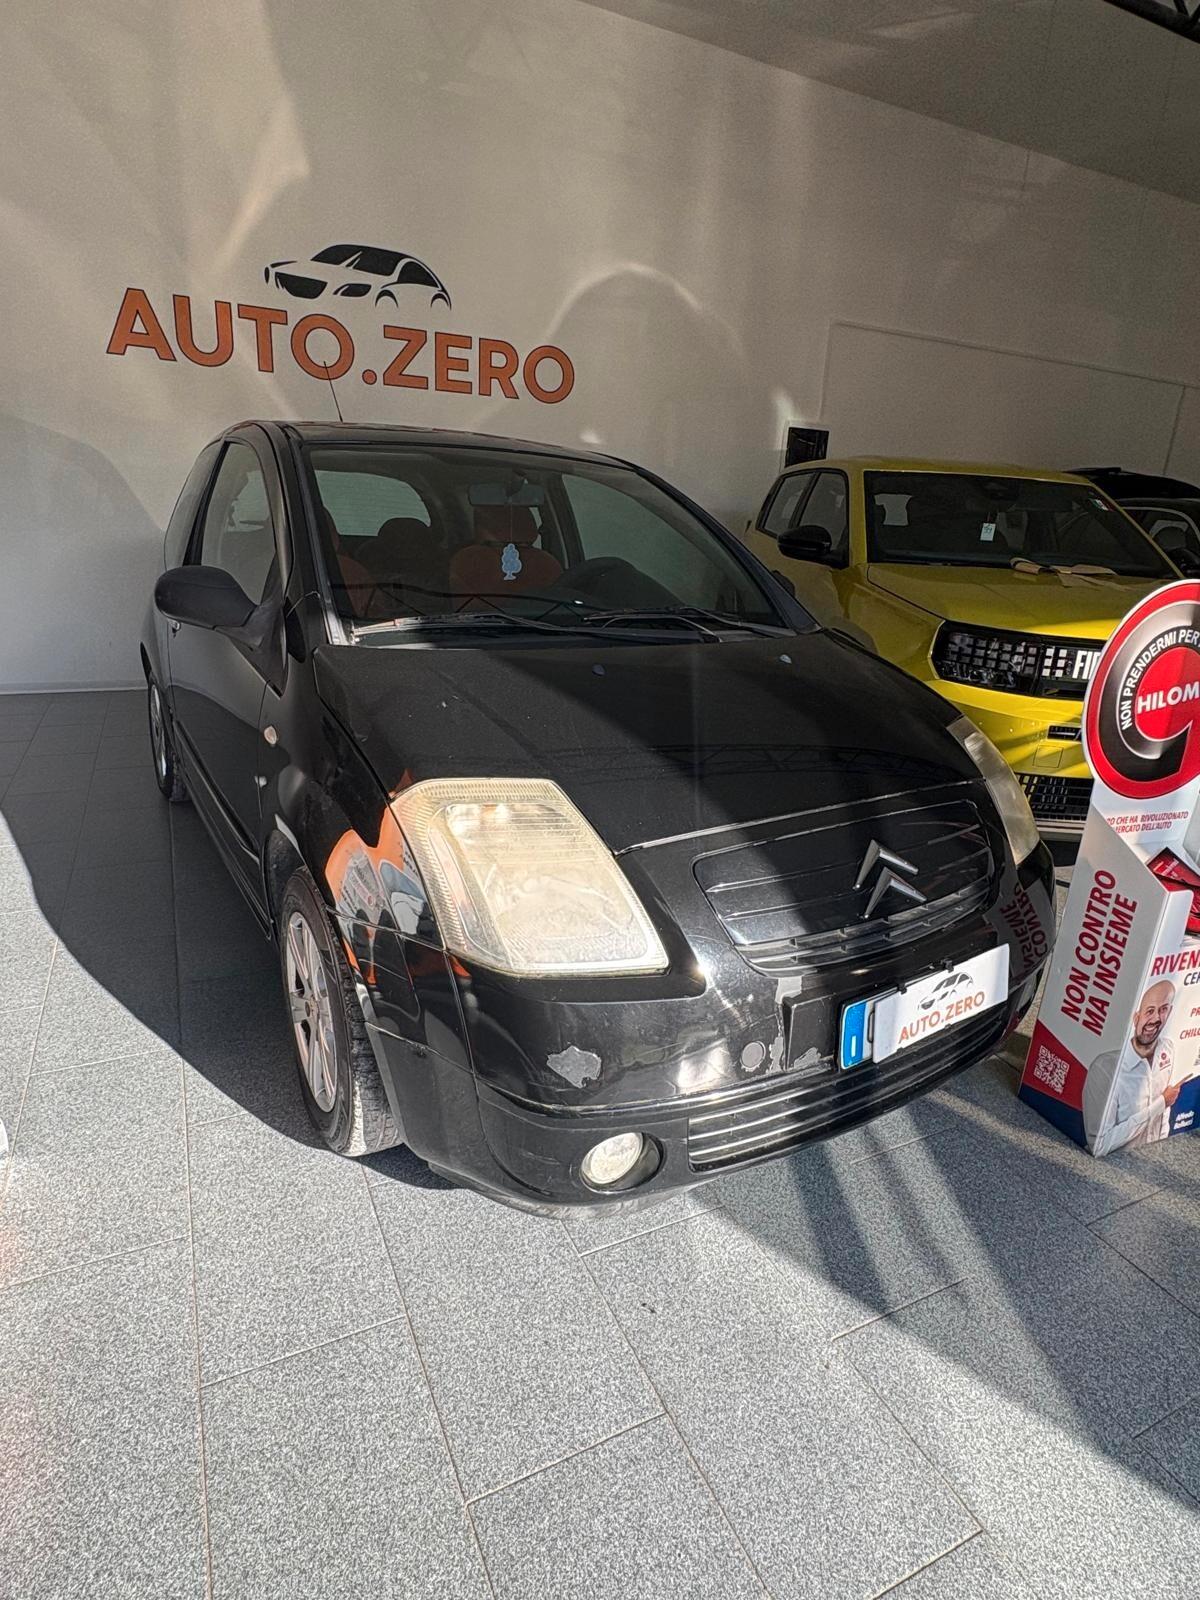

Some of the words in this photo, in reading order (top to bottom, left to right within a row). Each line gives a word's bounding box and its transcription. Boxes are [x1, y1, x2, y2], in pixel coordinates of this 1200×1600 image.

[106, 287, 575, 404] AUTO.ZERO
[1123, 630, 1177, 697] PRENDERMI
[1178, 629, 1200, 645] PER
[1120, 700, 1133, 730] NON
[1116, 815, 1128, 824] CHE
[1129, 815, 1138, 823] HA
[1140, 811, 1189, 822] RIVOLUZIONATO
[1074, 870, 1116, 966] CONTRO
[1093, 893, 1138, 996] INSIEME
[1150, 950, 1200, 977] RIVEN
[898, 991, 985, 1044] AUTO.ZERO
[1061, 966, 1091, 1022] NON
[1082, 999, 1110, 1037] MA
